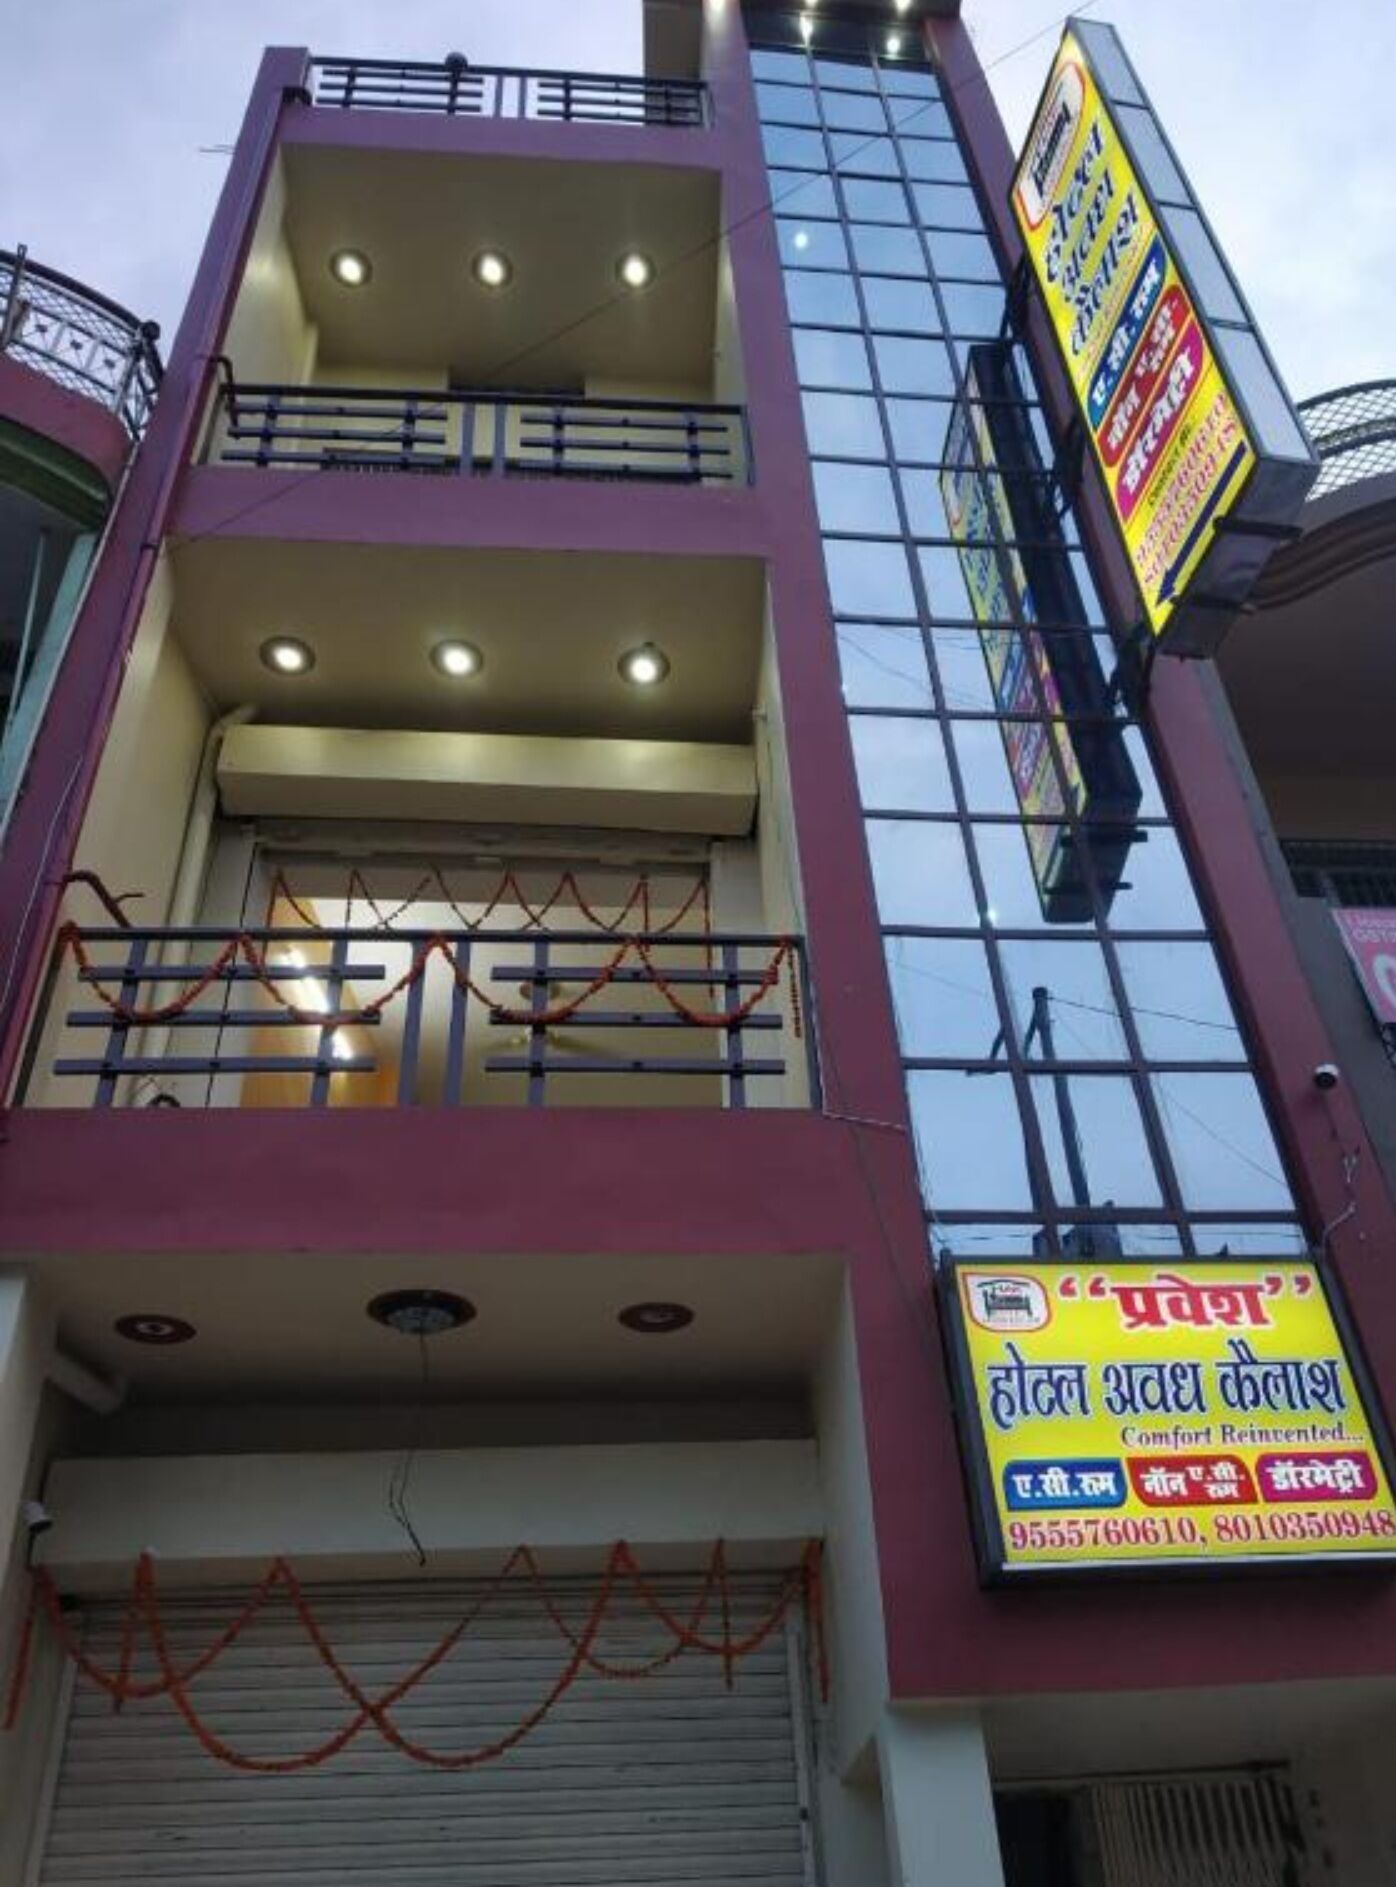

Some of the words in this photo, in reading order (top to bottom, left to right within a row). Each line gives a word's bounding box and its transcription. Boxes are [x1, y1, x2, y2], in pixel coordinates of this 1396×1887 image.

[987, 1342, 1091, 1431] होटल
[1103, 1362, 1207, 1416] अवध
[1216, 1339, 1346, 1414] कैलाश
[1121, 1426, 1211, 1449] Comfort
[1139, 1467, 1188, 1497] नॉन
[1214, 1509, 1396, 1543] 8010350948
